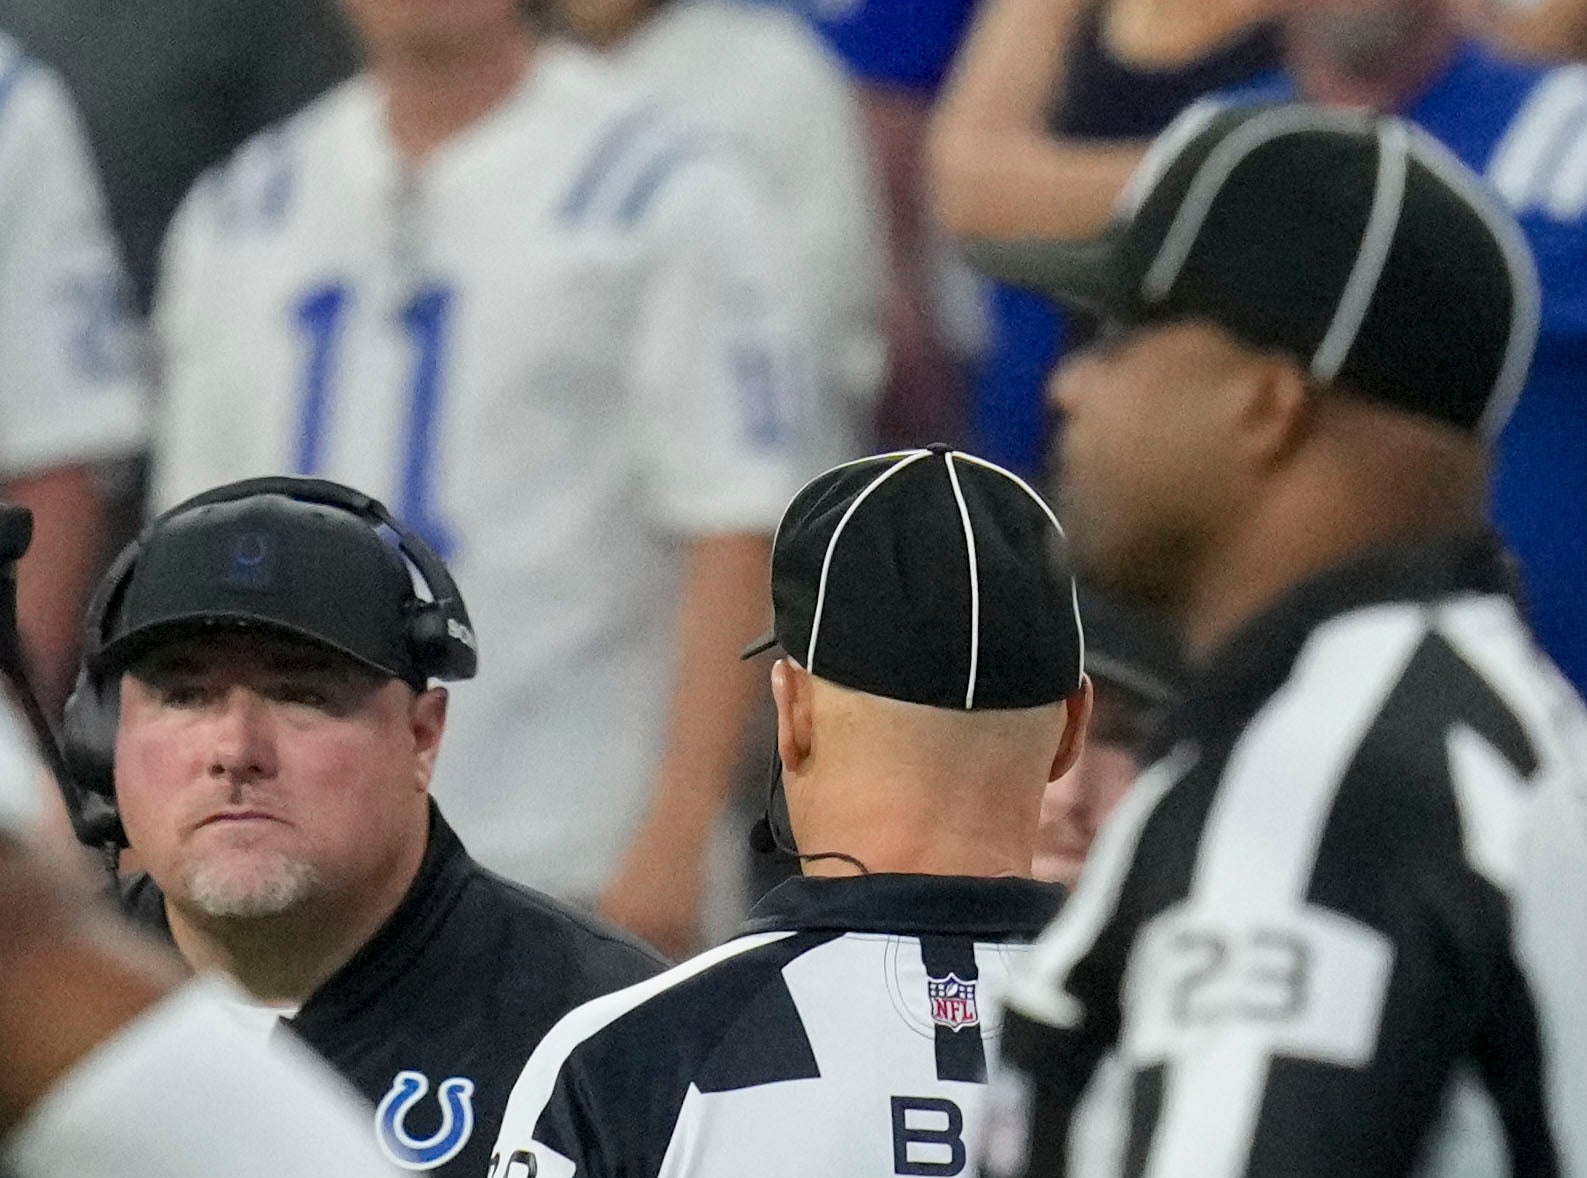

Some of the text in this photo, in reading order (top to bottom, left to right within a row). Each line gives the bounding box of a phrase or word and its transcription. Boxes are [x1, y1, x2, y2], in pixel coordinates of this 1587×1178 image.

[290, 280, 458, 560] 11
[935, 998, 974, 1022] NFL
[1170, 930, 1308, 1026] 23
